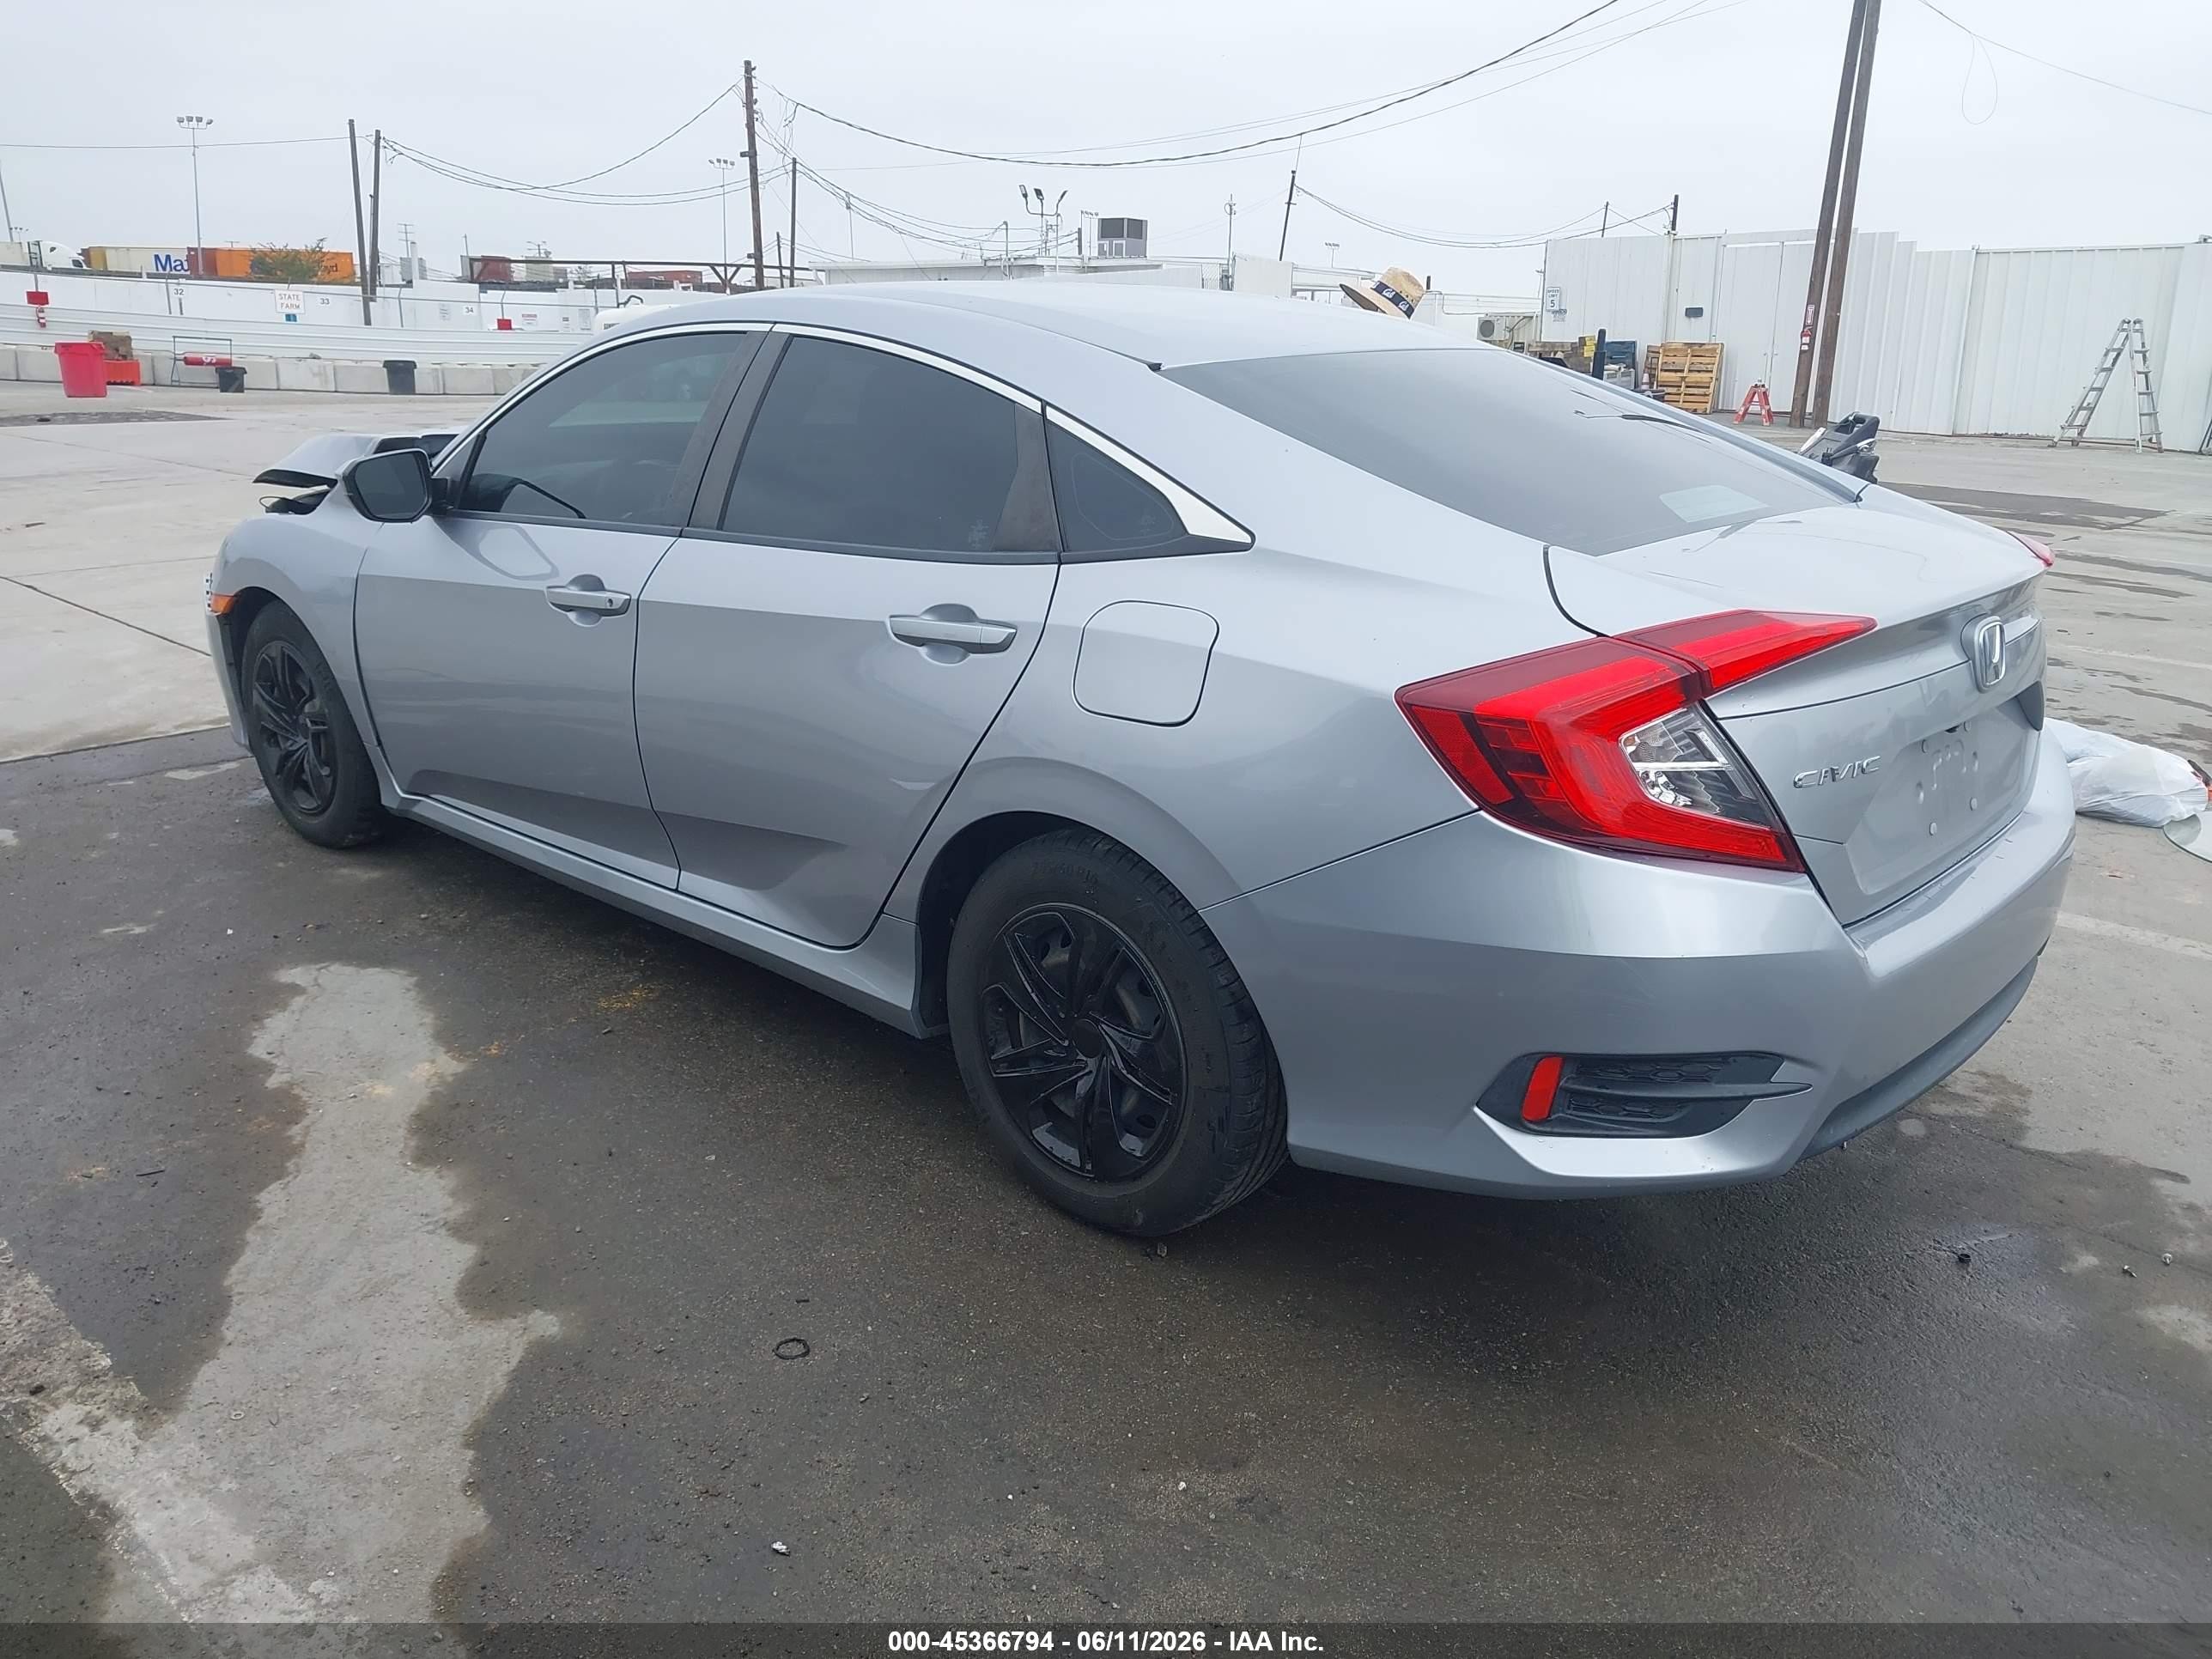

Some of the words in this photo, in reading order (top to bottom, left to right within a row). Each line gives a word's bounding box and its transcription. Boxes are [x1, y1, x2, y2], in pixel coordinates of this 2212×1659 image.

[278, 293, 301, 301] STATE
[1550, 299, 1556, 308] 5
[1793, 756, 1881, 789] CIVIC
